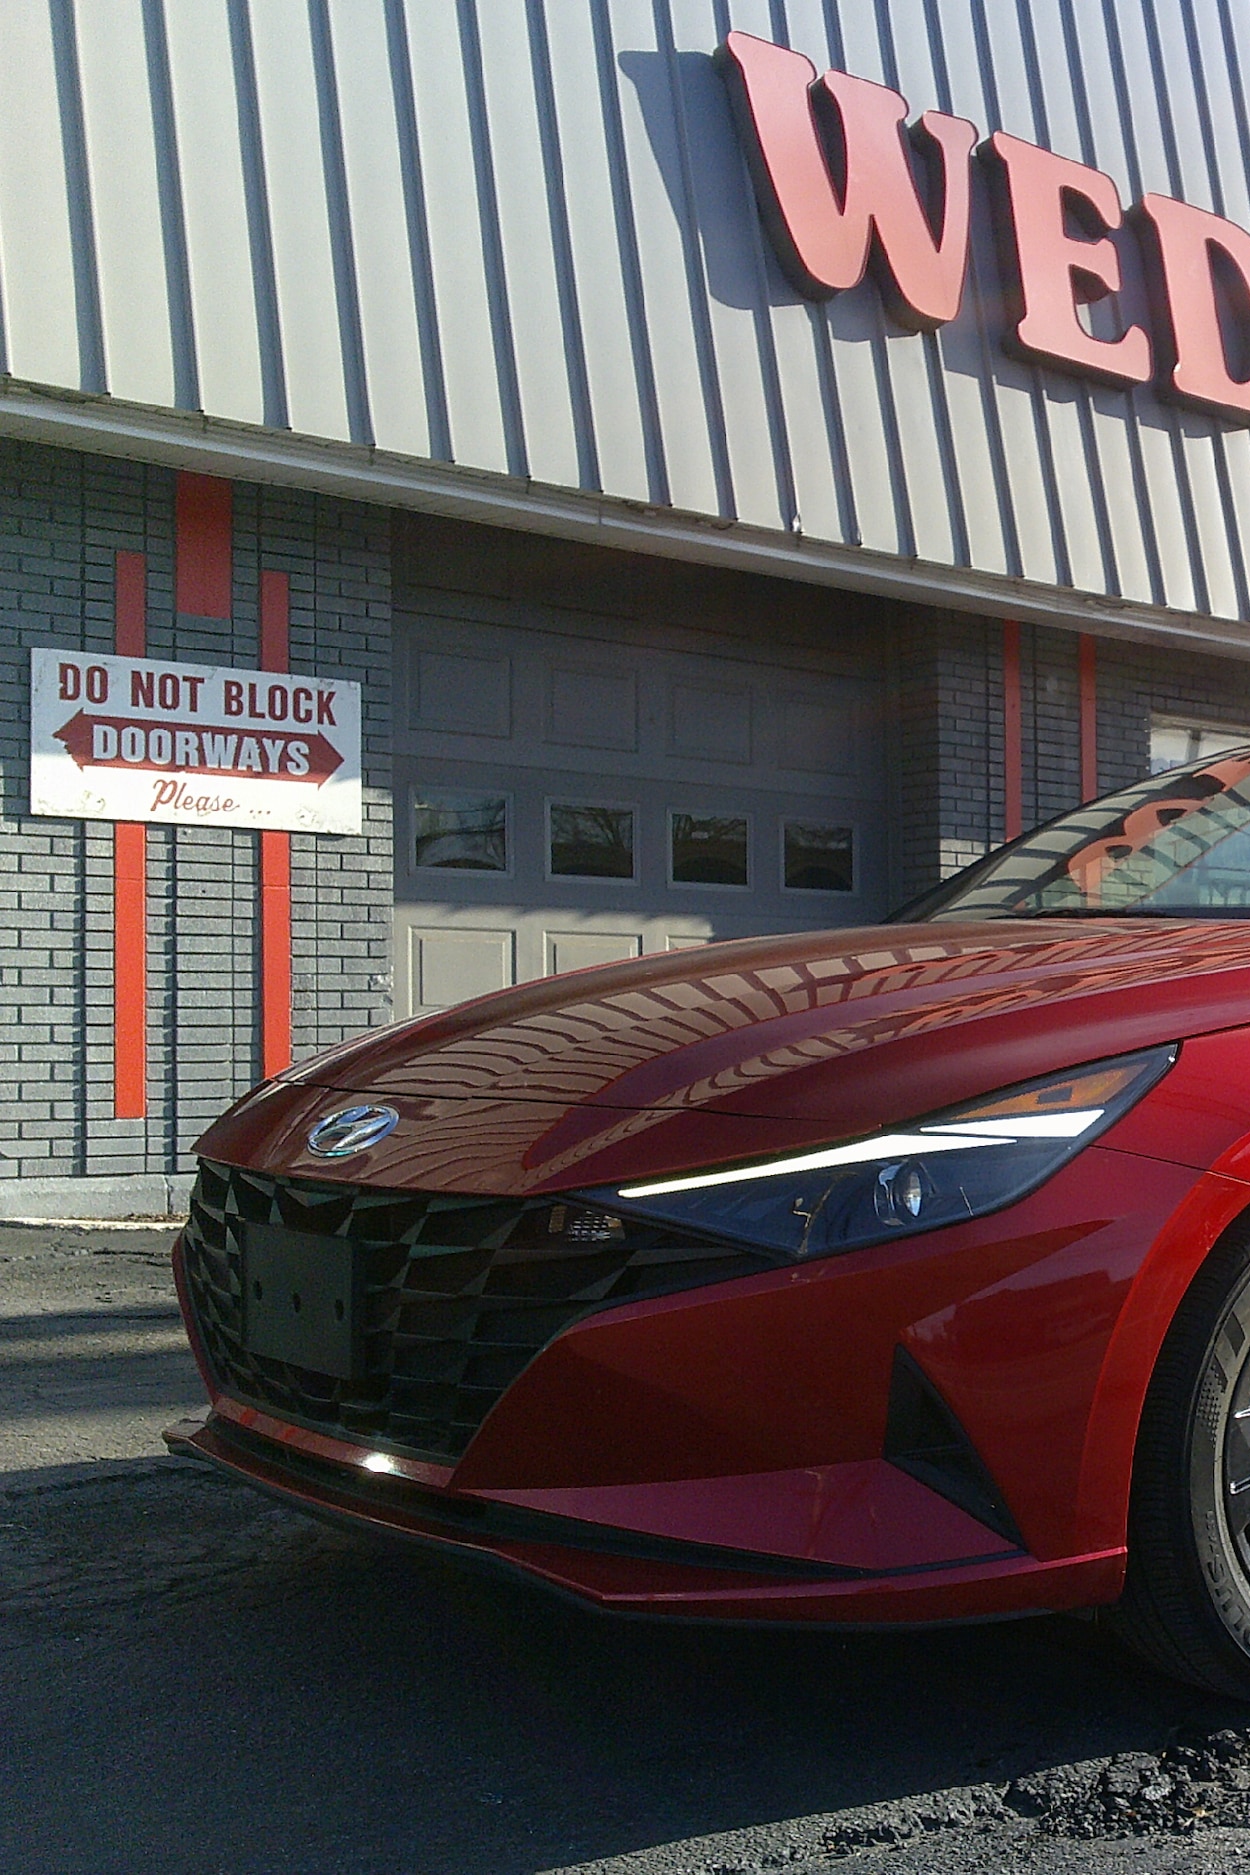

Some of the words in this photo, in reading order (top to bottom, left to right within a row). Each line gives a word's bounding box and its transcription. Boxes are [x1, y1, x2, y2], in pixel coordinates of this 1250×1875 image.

[58, 662, 109, 704] DO
[130, 670, 205, 713] NOT
[224, 679, 337, 727] BLOCK
[92, 724, 310, 776] DOORWAYS
[150, 779, 240, 813] Please
